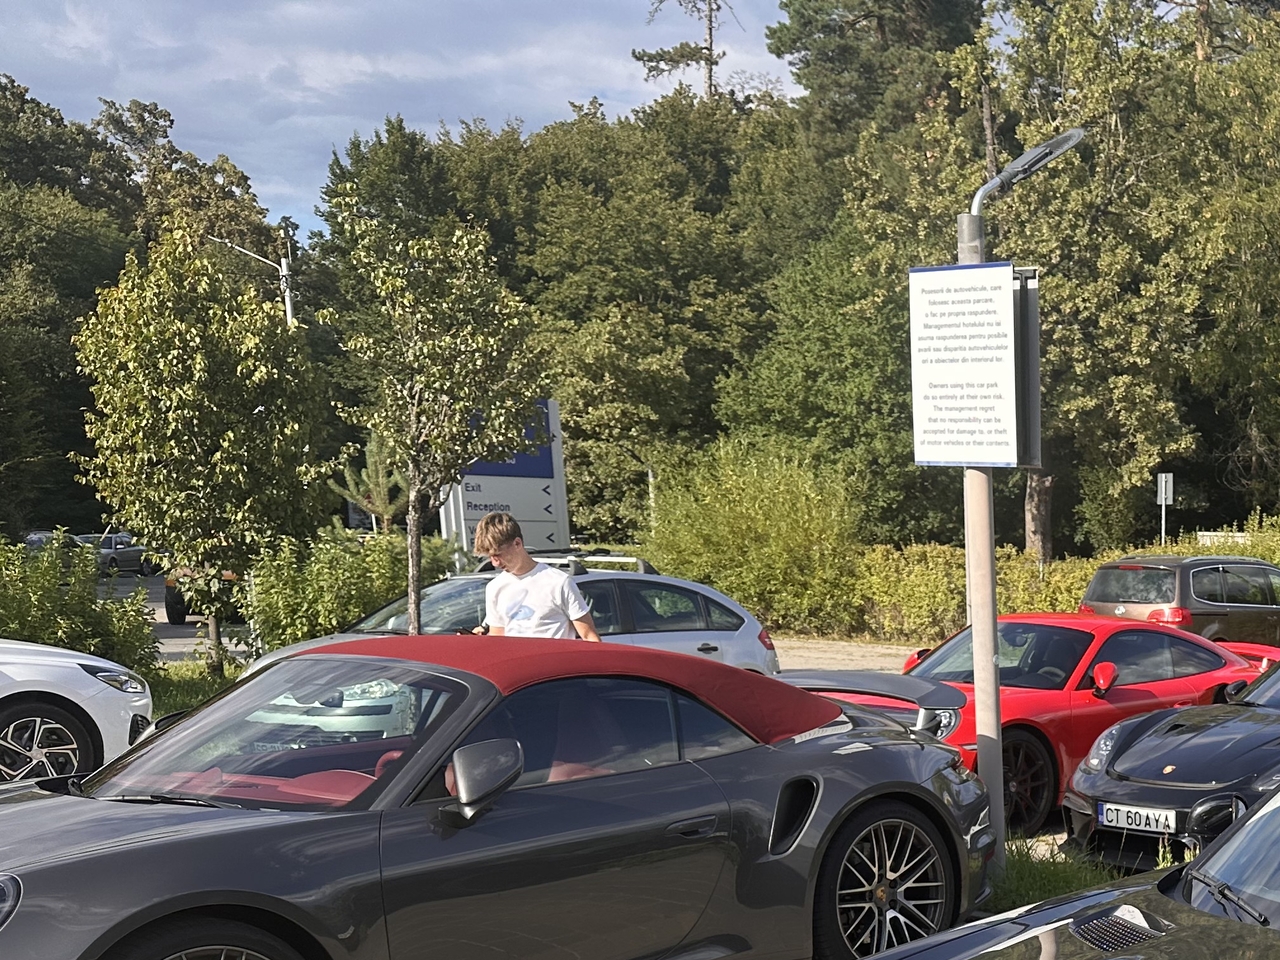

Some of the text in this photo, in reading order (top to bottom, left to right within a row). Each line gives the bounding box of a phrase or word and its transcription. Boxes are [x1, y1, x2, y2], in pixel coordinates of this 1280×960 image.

[923, 322, 961, 330] Managementul
[936, 334, 967, 342] raspunderea
[988, 332, 1007, 340] posibile
[465, 483, 481, 492] Exit
[467, 502, 510, 512] Reception
[1106, 808, 1120, 824] CT
